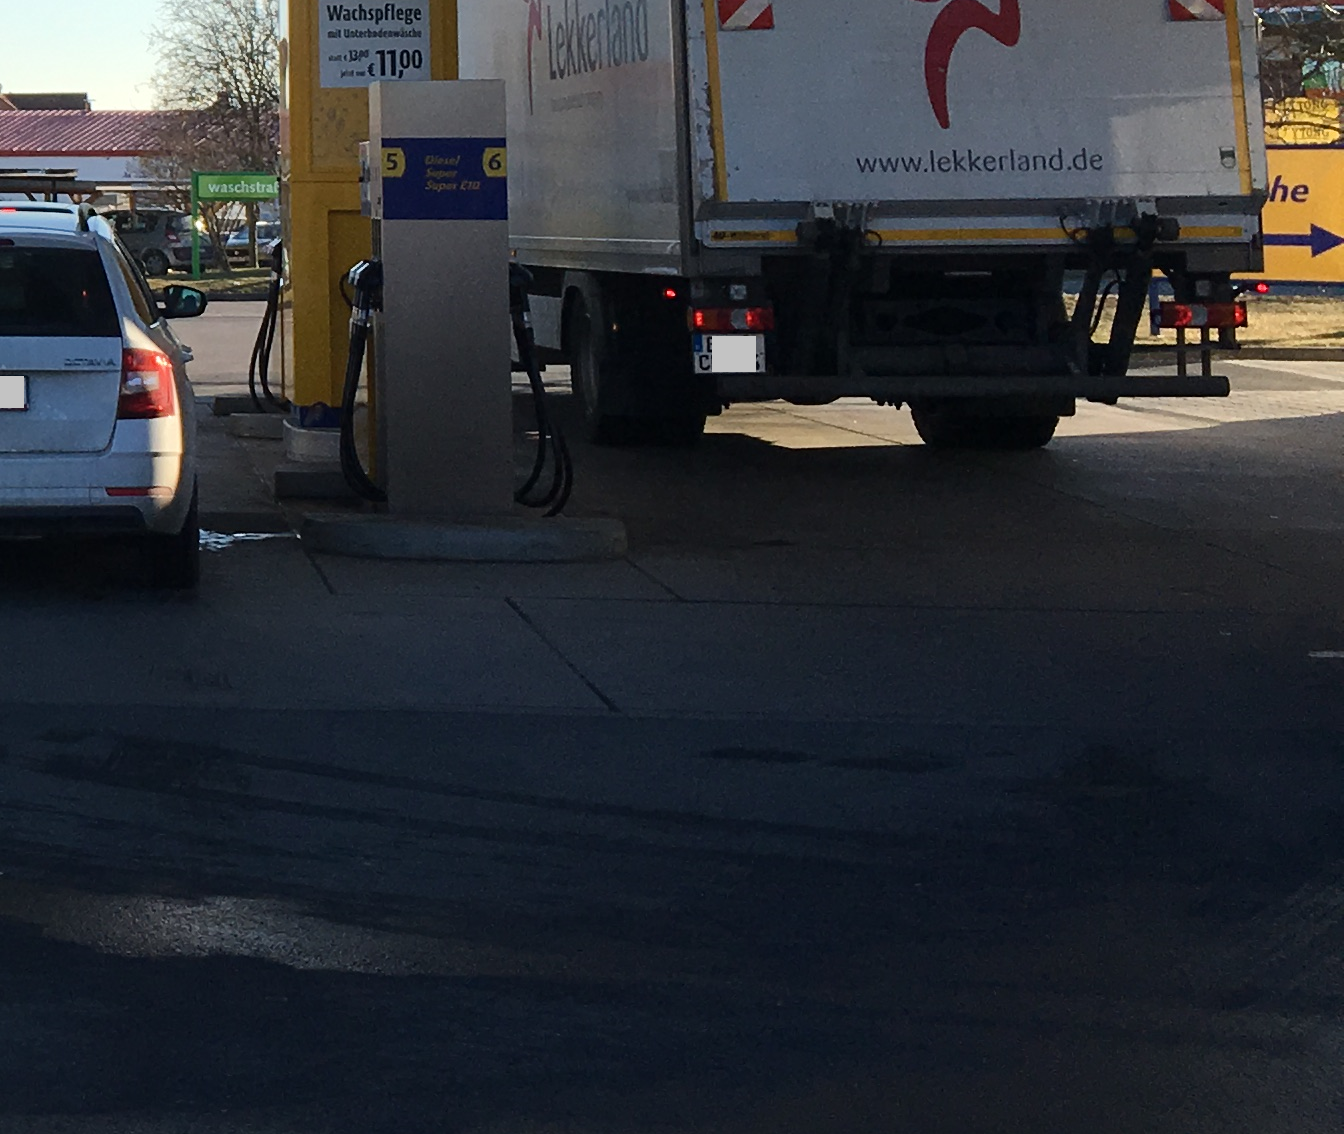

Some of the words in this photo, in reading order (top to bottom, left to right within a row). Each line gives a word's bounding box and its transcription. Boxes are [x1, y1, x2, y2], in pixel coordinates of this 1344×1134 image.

[326, 3, 422, 25] Wachspflege
[327, 29, 342, 39] mit
[343, 27, 422, 39] Unterbodenwäsche
[386, 152, 398, 171] 5
[488, 152, 502, 171] 6
[856, 147, 1104, 173] www.lekkerland.de
[1269, 174, 1309, 203] he
